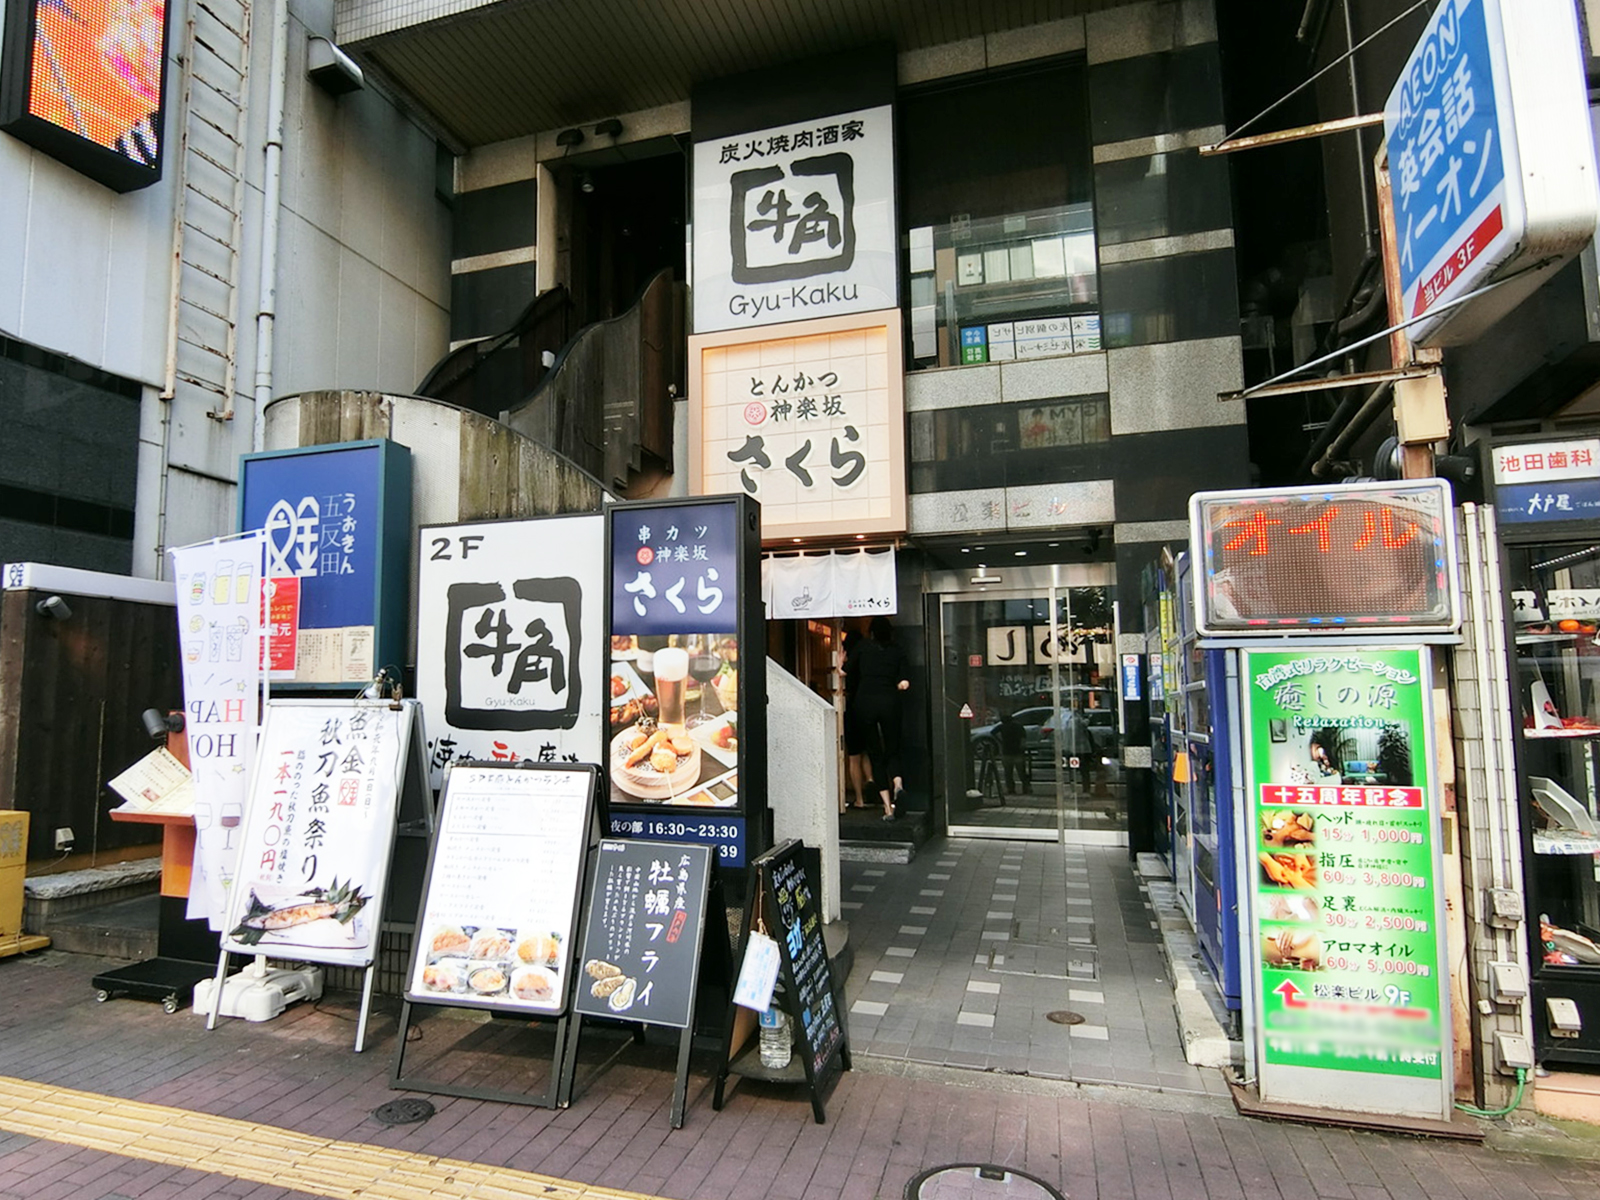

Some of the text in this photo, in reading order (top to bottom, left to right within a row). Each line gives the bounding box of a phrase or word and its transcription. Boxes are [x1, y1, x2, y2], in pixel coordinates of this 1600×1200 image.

[1401, 8, 1459, 127] AEON
[719, 120, 865, 164] 炭火焼肉酒家
[1398, 53, 1476, 212] 英会話
[1401, 129, 1492, 273] イーオン
[747, 189, 841, 254] 牛角
[1424, 238, 1477, 306] 当ビル 3F
[729, 282, 859, 318] Gyu-Kaku
[750, 372, 839, 396] とんかつ
[770, 395, 847, 422] 神楽坂
[727, 426, 867, 493] さくら
[1500, 448, 1593, 473] 池田歯科
[1528, 493, 1573, 515] 大戸屋
[321, 494, 343, 576] 五反田
[340, 493, 356, 575] うおきん
[637, 524, 708, 542] 串カツ
[1223, 506, 1418, 555] オイル
[430, 536, 484, 561] 2F
[655, 545, 709, 563] 神楽坂
[624, 567, 724, 617] さくら
[867, 597, 890, 608] さくら
[463, 607, 566, 694] 牛角
[1255, 656, 1417, 690] 台湾式リラクゼーション
[485, 697, 535, 706] Gyu-Kaku
[1273, 682, 1398, 711] 癒しの源
[1293, 714, 1386, 730] Relaxation
[340, 711, 368, 775] 魚金
[301, 718, 343, 883] 秋刀魚祭り
[1274, 787, 1409, 807] 十五周年記念
[611, 820, 643, 833] 夜の部
[1317, 811, 1354, 825] ヘッド
[1322, 828, 1423, 844] 15分 1,000円
[1319, 852, 1355, 867] 指圧
[674, 854, 691, 910] 広島県産
[1323, 870, 1426, 888] 60分 3,800円
[1322, 895, 1357, 912] 足裏
[637, 859, 675, 1006] 牡蠣フライ
[1325, 913, 1428, 932] 30分 2,500円
[1323, 940, 1415, 957] アロマオイル
[1327, 957, 1430, 977] 60分 5,000円
[1314, 983, 1412, 1006] 松楽ビル 9F
